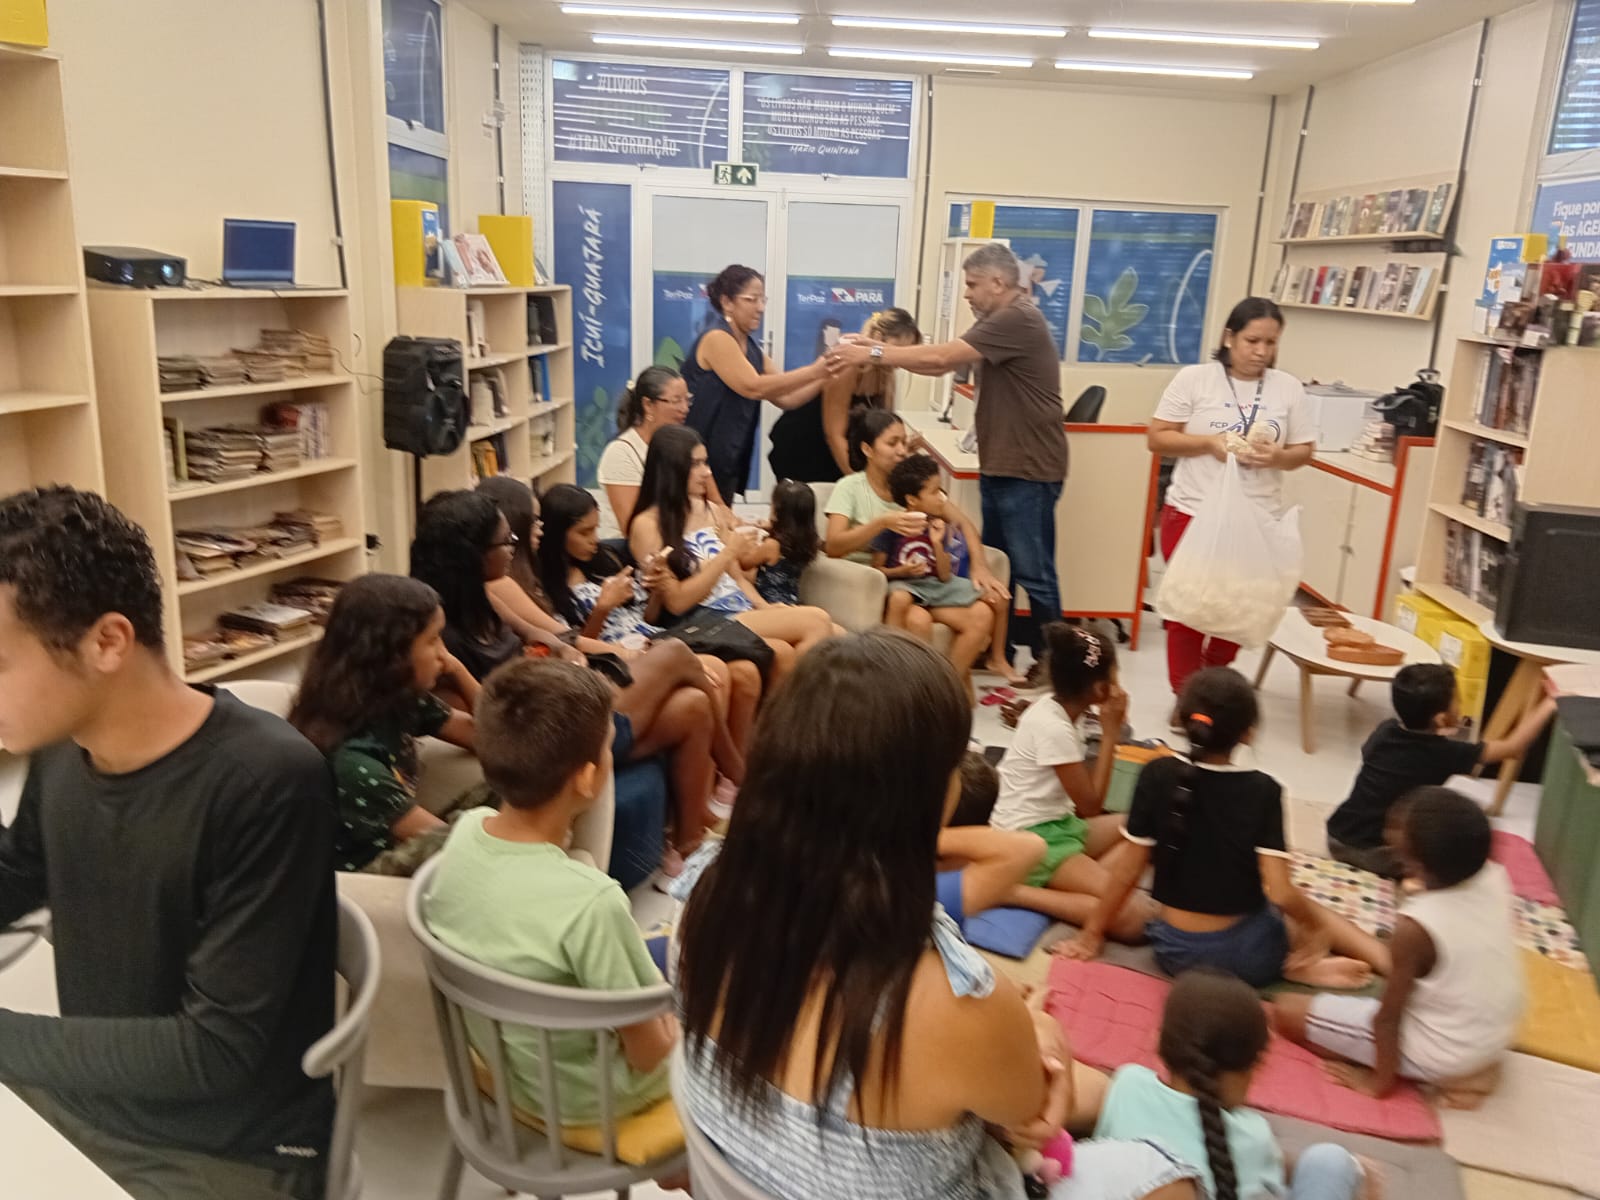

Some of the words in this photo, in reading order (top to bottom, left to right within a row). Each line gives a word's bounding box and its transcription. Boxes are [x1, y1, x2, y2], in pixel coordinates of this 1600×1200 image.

[598, 76, 648, 95] #LIVROS
[813, 99, 840, 112] MUDAM
[876, 102, 897, 115] QUEM
[771, 111, 791, 122] MUDA
[799, 112, 824, 124] MUNDO
[825, 111, 839, 125] SÃO
[777, 125, 802, 137] LIVROS
[813, 126, 840, 139] MUDAM
[568, 134, 677, 159] #TRANSFORMAÇÃO
[1553, 201, 1582, 220] Fique
[1209, 421, 1229, 429] FCP
